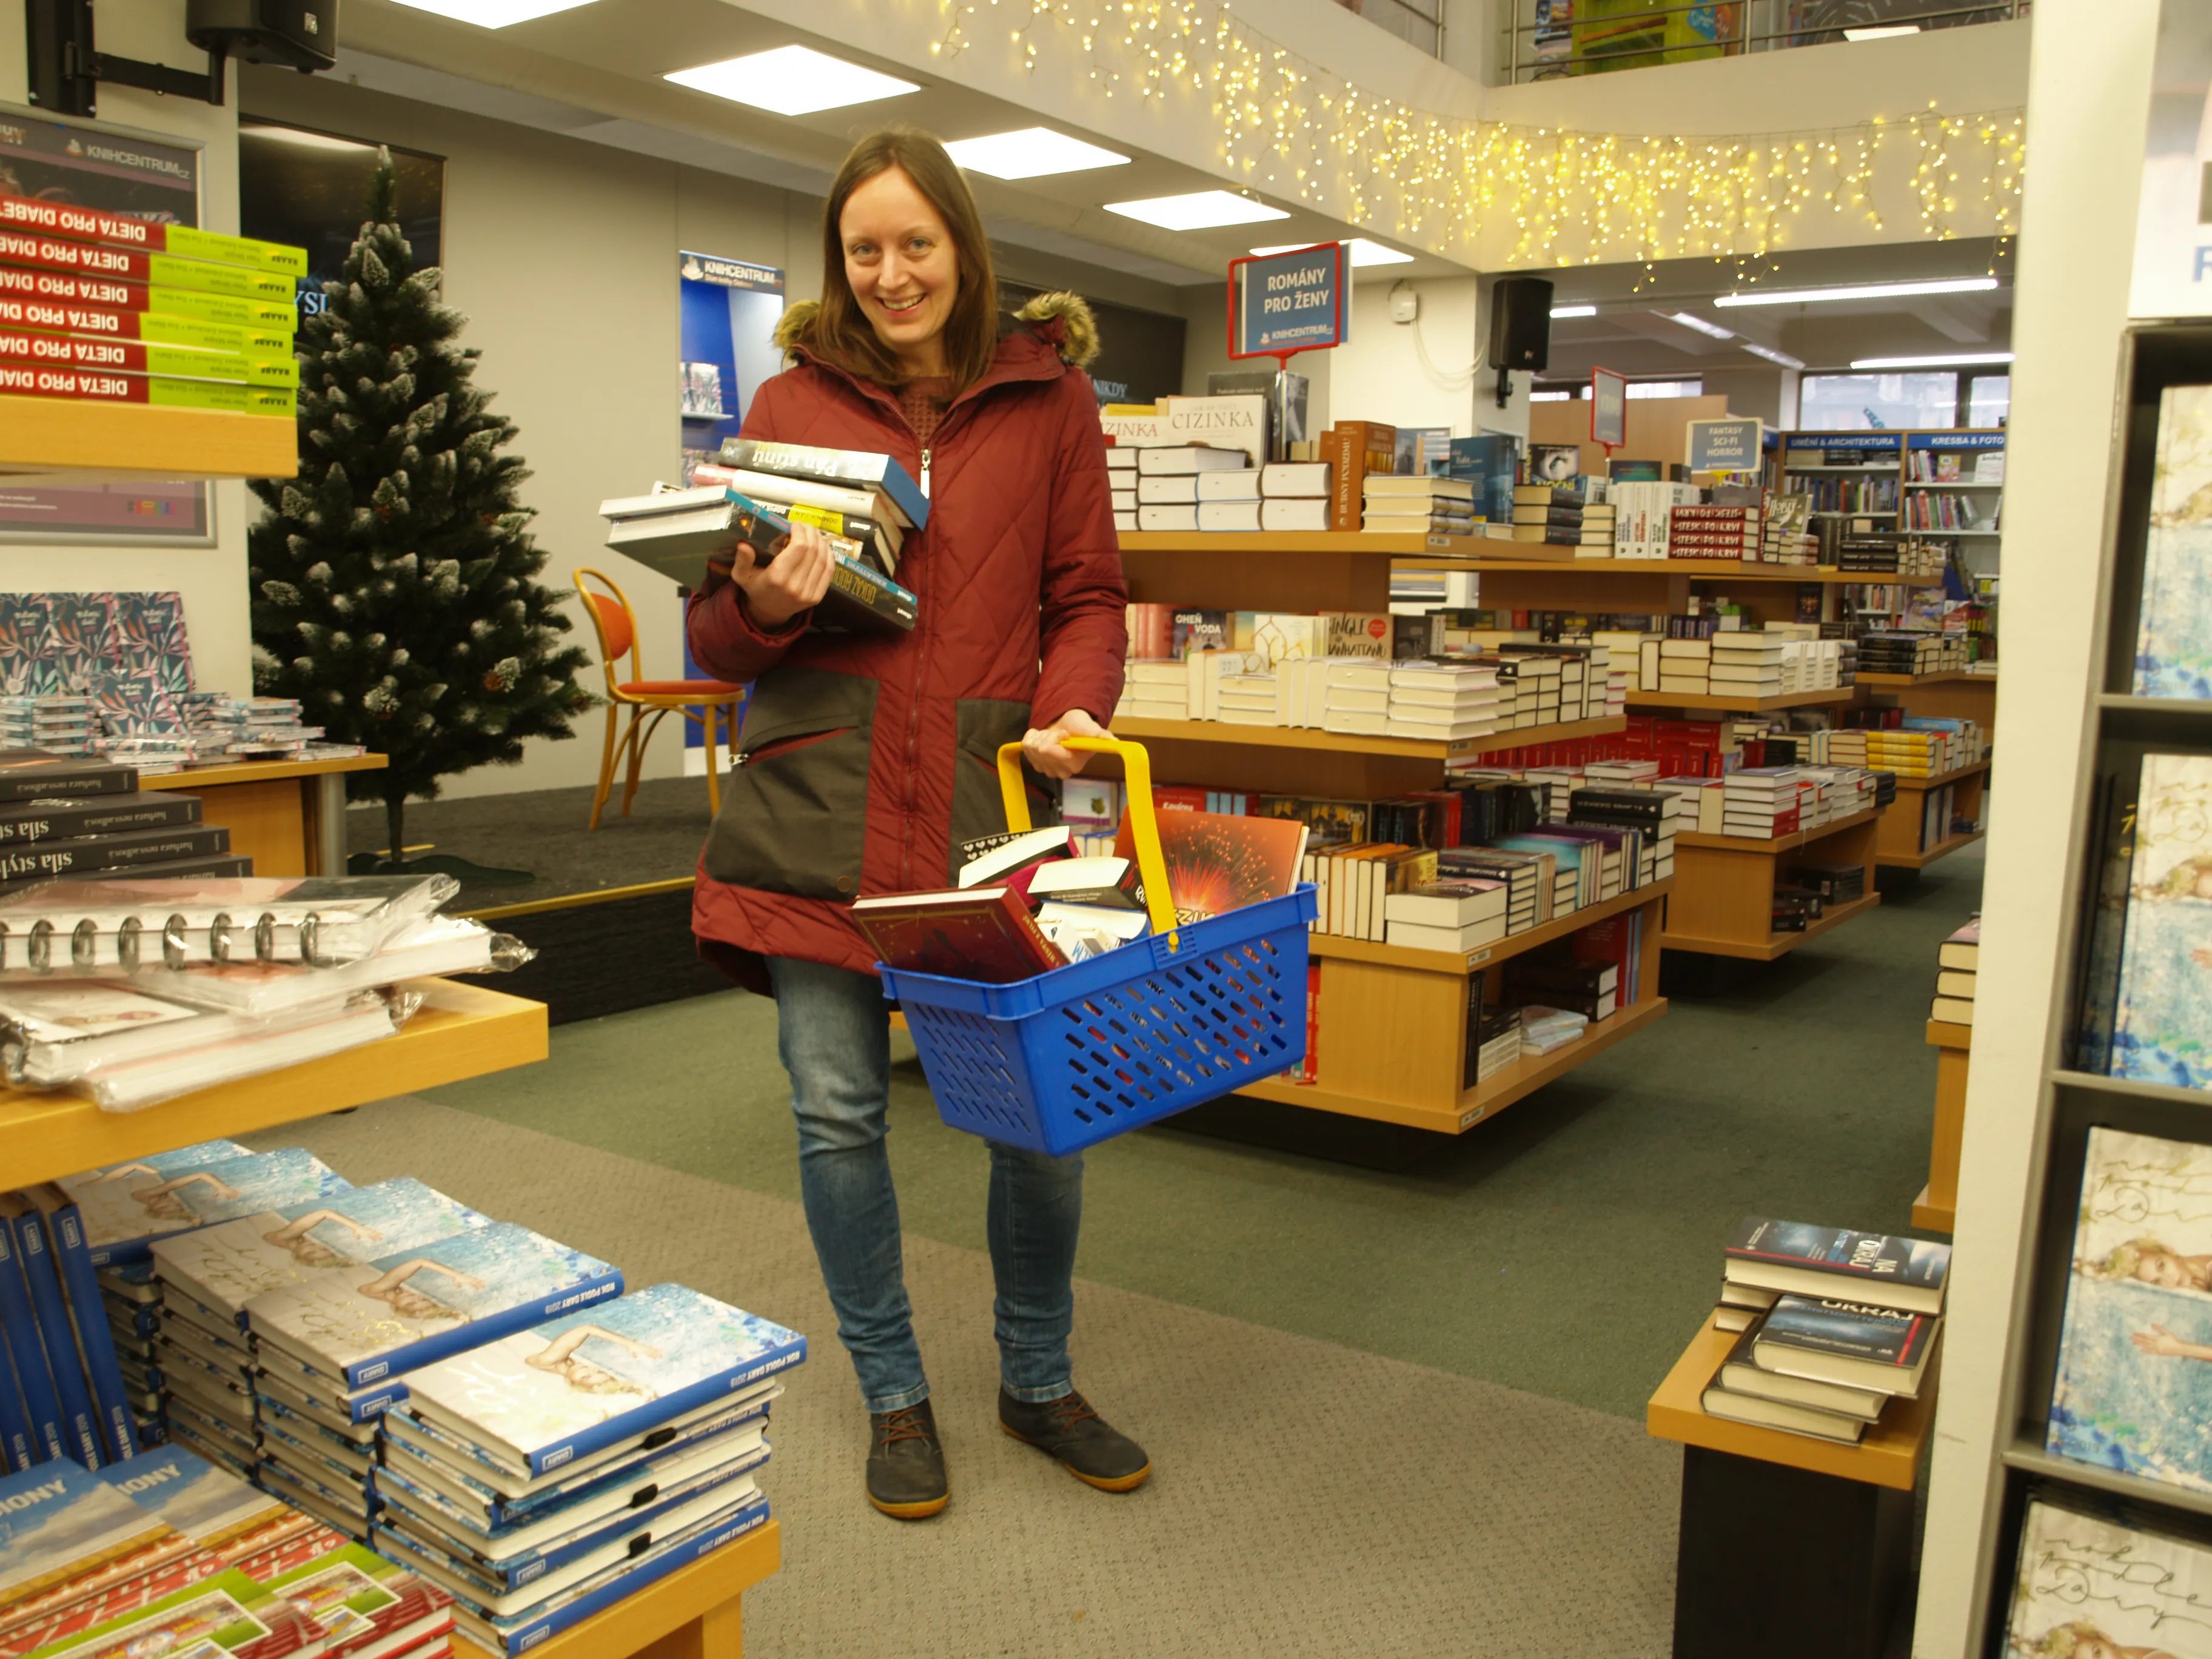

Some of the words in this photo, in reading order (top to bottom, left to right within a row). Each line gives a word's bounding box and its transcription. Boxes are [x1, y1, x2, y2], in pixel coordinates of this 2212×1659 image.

[87, 145, 179, 174] KNIHCENTRUM
[0, 201, 56, 226] DIABE
[61, 212, 96, 233] PRO
[99, 219, 146, 242] DIETA
[41, 244, 77, 264] PRO
[81, 252, 129, 271] DIETA
[0, 271, 33, 291] DIA
[704, 260, 776, 284] KNIHCENTRUM
[1267, 267, 1326, 292] ROMÁNY
[39, 277, 75, 296] PRO
[79, 284, 128, 303] DIETA
[1264, 296, 1292, 315] PRO
[1294, 289, 1329, 310] ŽENY
[26, 305, 64, 325] PRO
[69, 312, 119, 331] DIETA
[1272, 324, 1327, 340] KNIHCENTRUM
[33, 339, 72, 358] PRO
[75, 344, 125, 364] DIETA
[0, 370, 34, 389] DIA
[38, 372, 75, 392] PRO
[80, 376, 128, 396] DIETA
[1171, 410, 1254, 429] CIZINKA
[1709, 426, 1744, 435] FANTASY
[1713, 437, 1738, 446] SCI-FI
[1828, 436, 1894, 447] ARCHITEKTURA
[1931, 436, 1969, 446] KRESBA
[752, 448, 801, 470] stínů
[1706, 447, 1744, 457] HORROR
[805, 456, 839, 477] Pán
[851, 577, 877, 605] ODKAZ
[1175, 612, 1202, 624] OHEŇ
[1195, 624, 1221, 634] VODA
[18, 820, 49, 841] síla
[41, 851, 73, 874] síla
[1849, 1239, 1880, 1269] OKRAJ
[1872, 1258, 1898, 1273] NA
[600, 1282, 615, 1295] ROK
[561, 1294, 580, 1309] DARY
[786, 1350, 800, 1364] ROK
[746, 1366, 765, 1382] DARY
[714, 1530, 731, 1546] DARY
